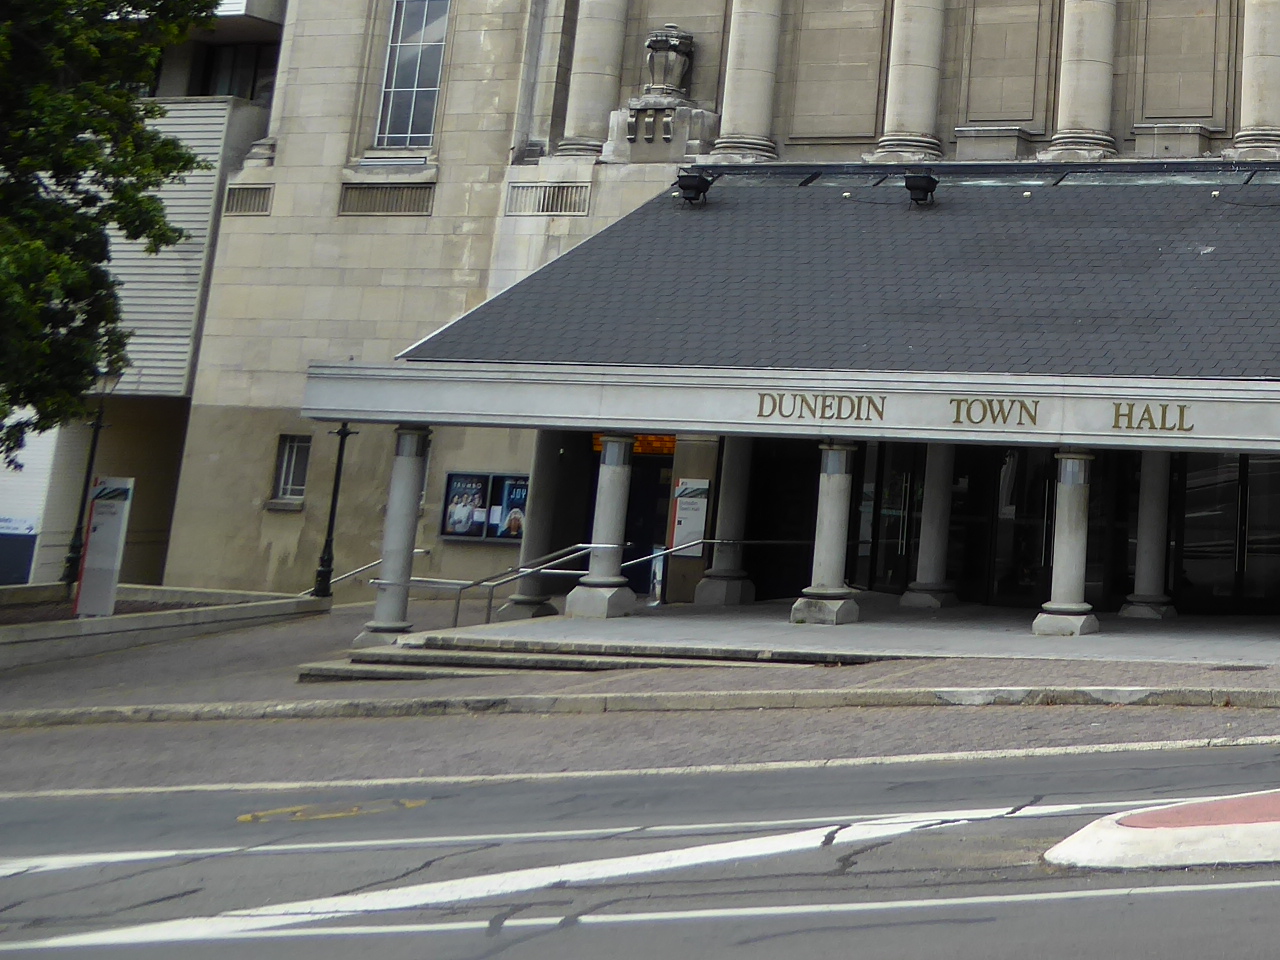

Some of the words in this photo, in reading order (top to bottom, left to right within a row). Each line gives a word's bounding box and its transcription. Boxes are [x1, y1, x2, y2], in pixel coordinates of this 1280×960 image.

[757, 392, 887, 421] DUNEDIN
[950, 398, 1040, 426] TOWN
[1112, 402, 1195, 432] HALL
[510, 488, 527, 499] JOY
